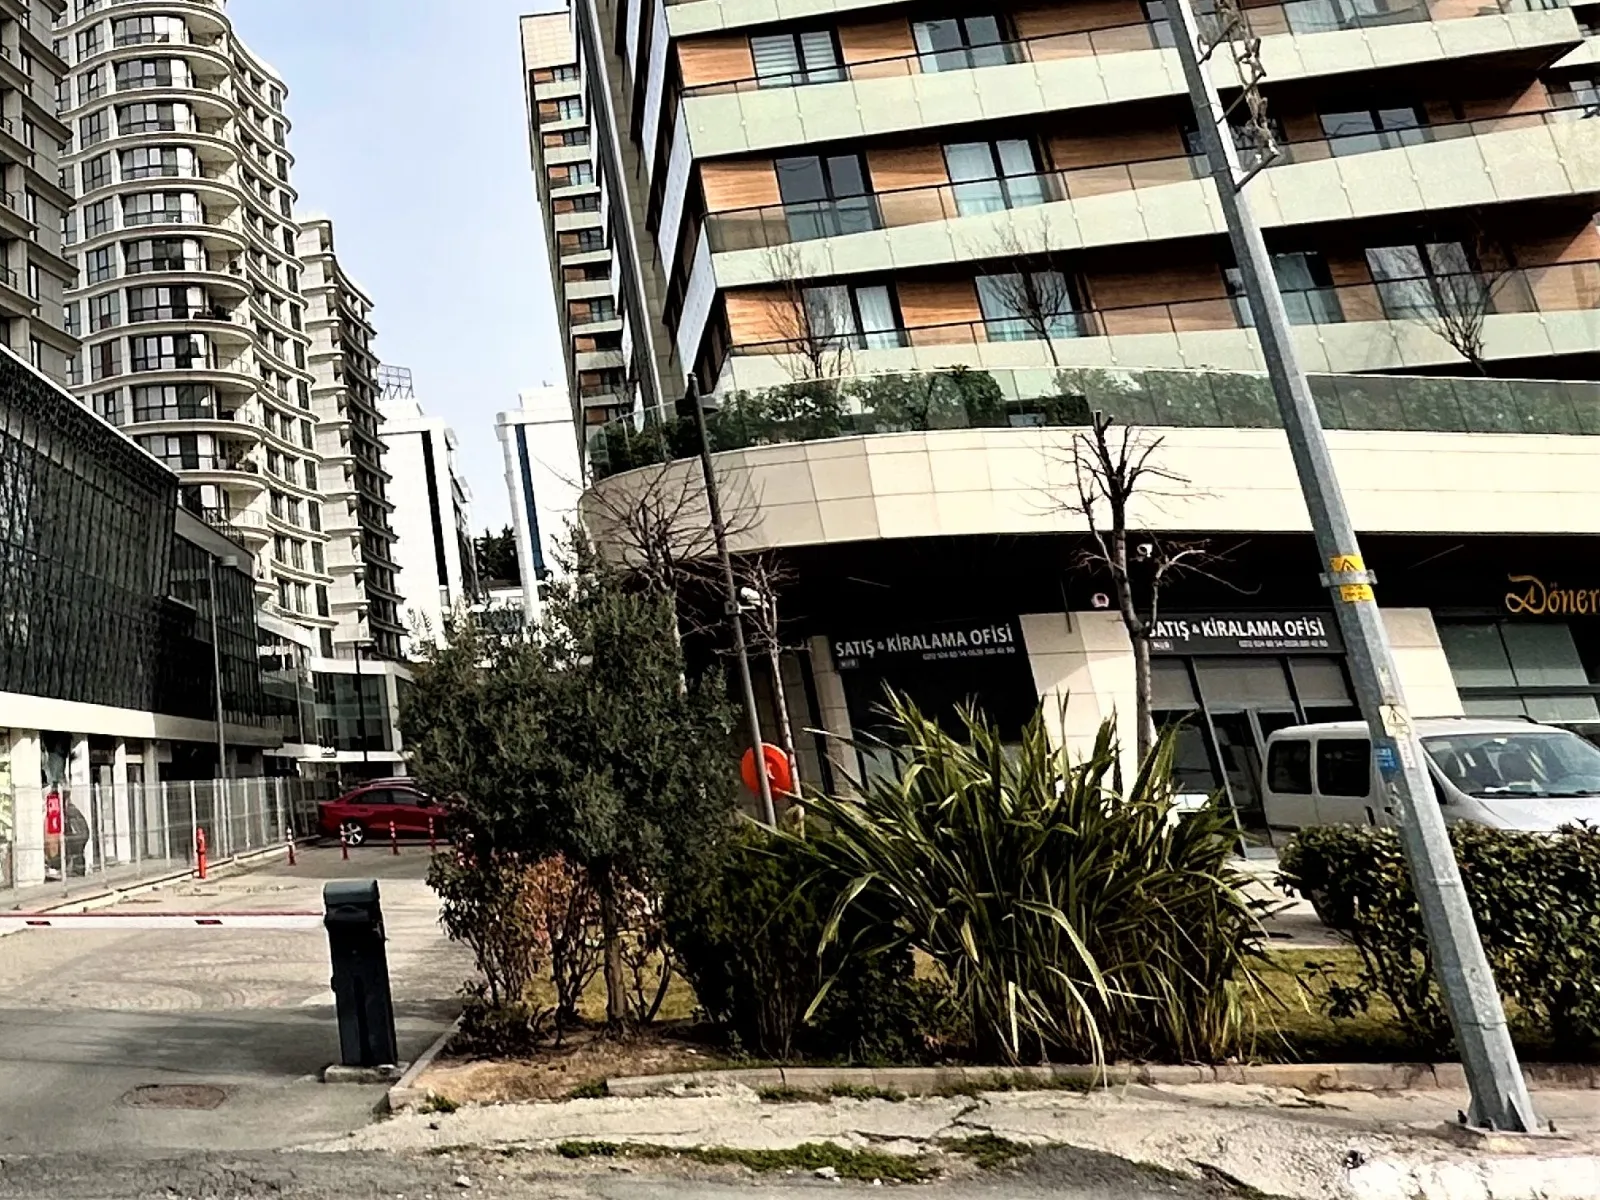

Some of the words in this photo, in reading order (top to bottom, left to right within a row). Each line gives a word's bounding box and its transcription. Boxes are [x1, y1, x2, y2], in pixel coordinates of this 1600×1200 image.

[836, 639, 875, 658] SATIŞ
[886, 630, 968, 652] KİRALAMA
[970, 623, 1014, 645] OFİSİ
[1201, 616, 1283, 637] KİRALAMA
[1284, 616, 1325, 636] OFİSİ
